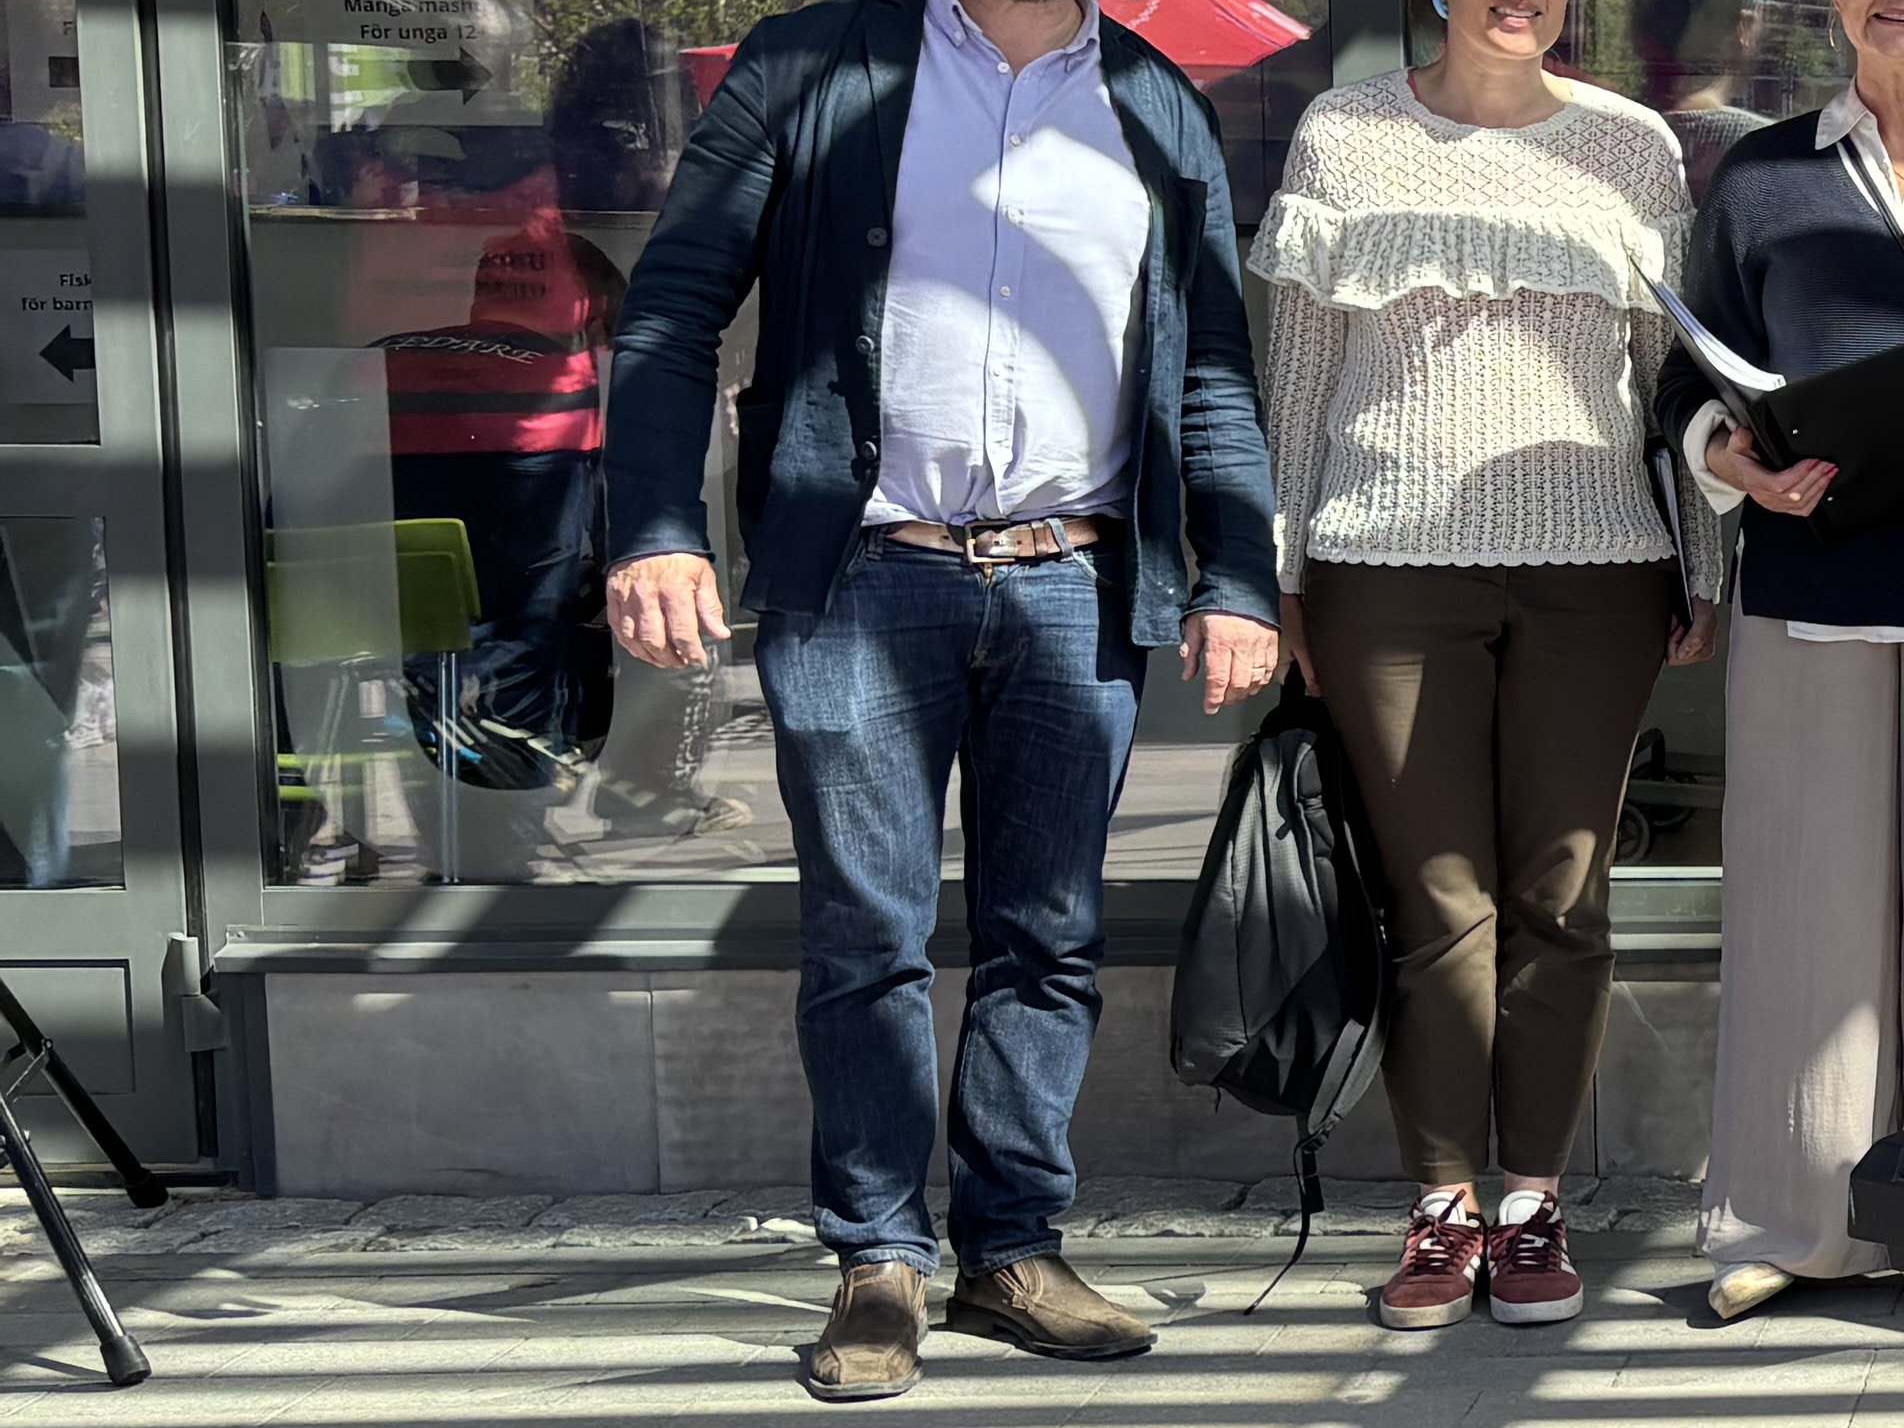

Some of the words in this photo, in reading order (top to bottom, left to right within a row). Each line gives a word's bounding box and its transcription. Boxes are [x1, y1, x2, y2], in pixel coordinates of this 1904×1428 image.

[360, 23, 391, 39] För
[399, 26, 448, 43] unga
[22, 297, 46, 310] för
